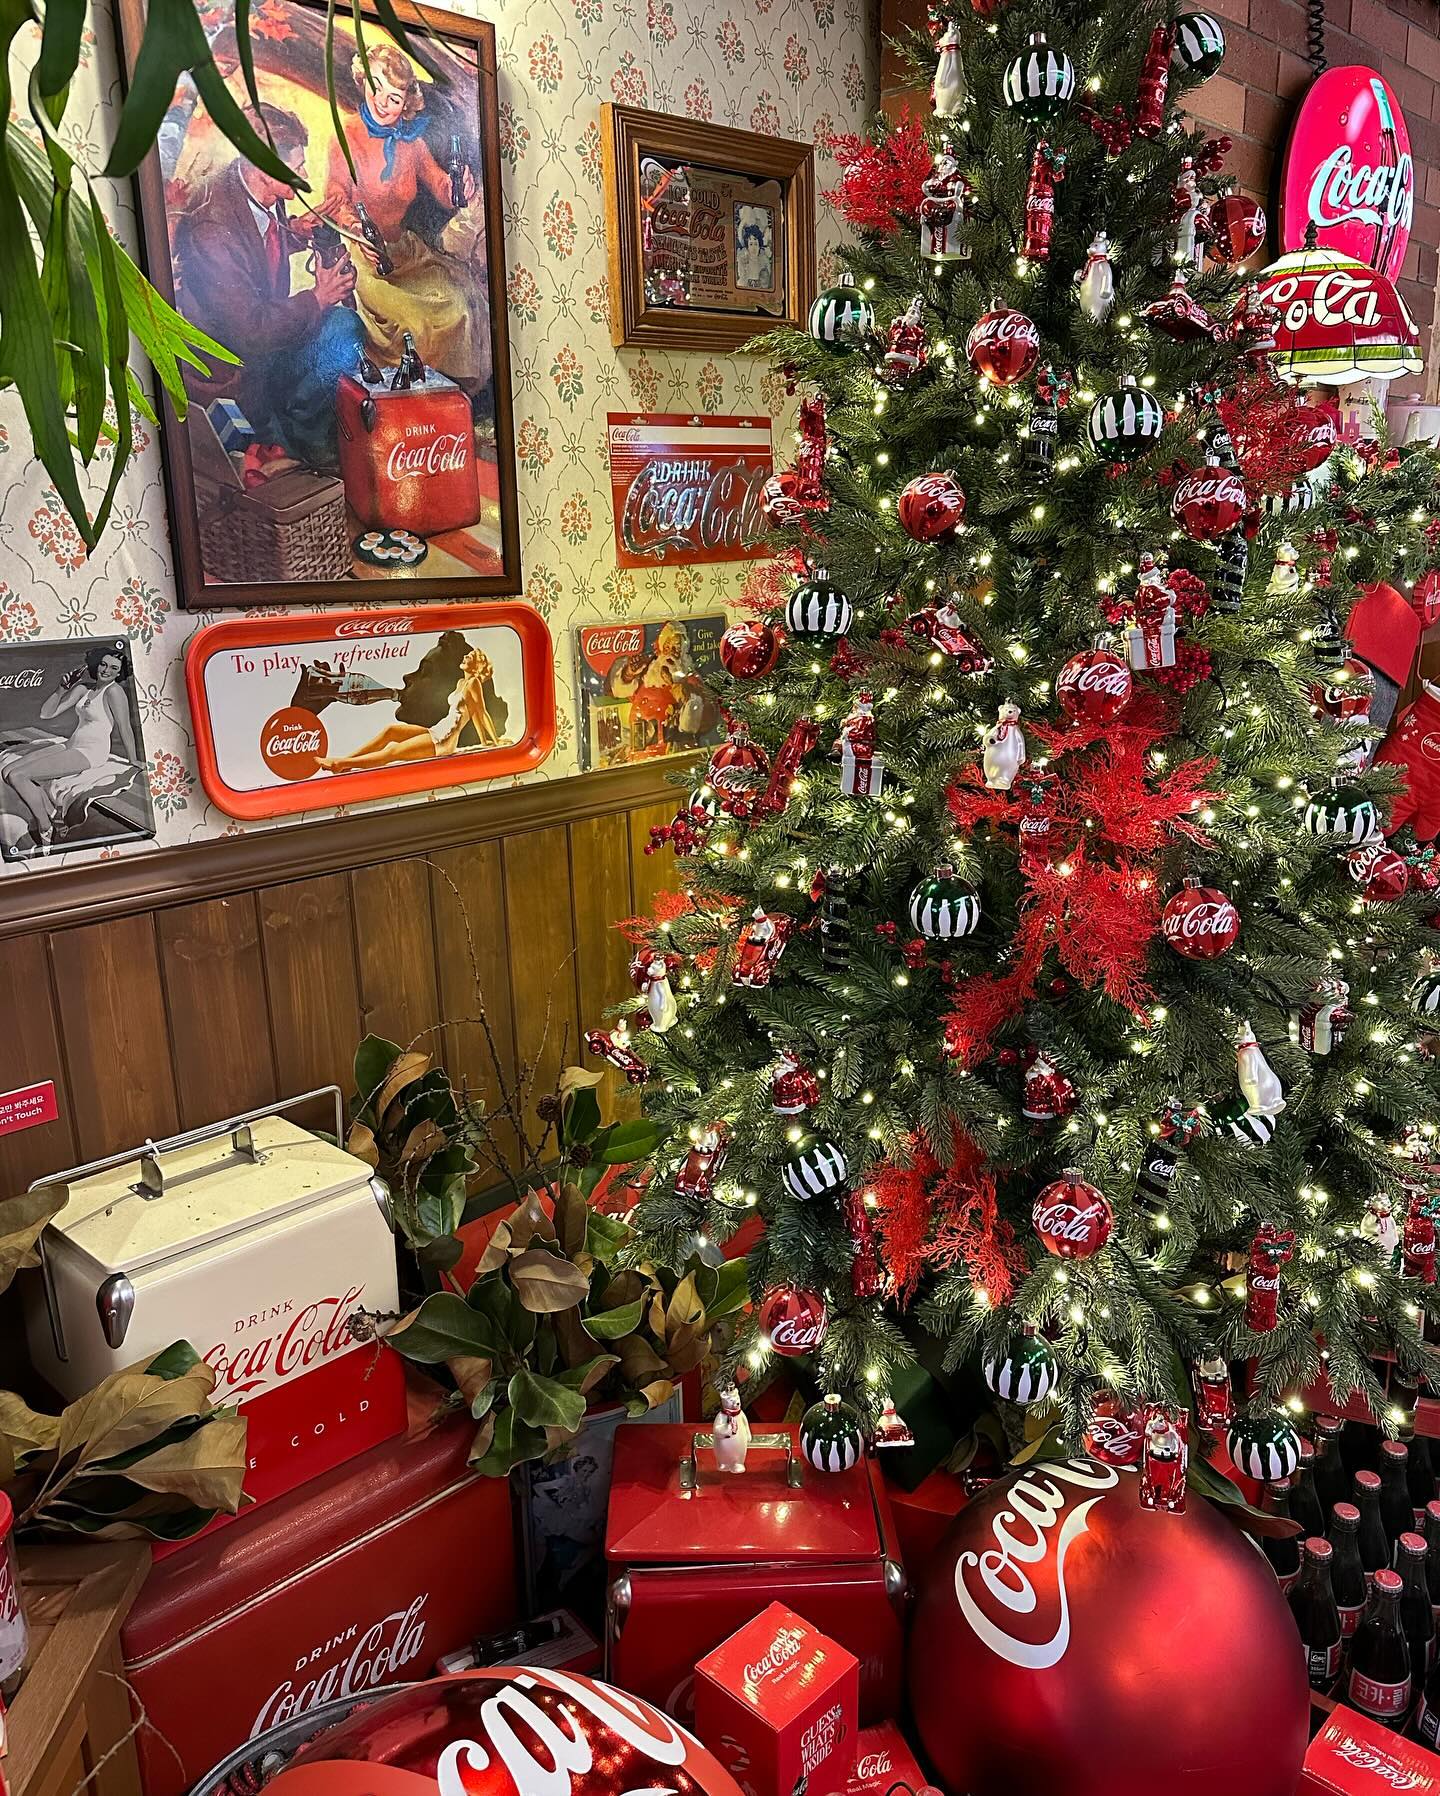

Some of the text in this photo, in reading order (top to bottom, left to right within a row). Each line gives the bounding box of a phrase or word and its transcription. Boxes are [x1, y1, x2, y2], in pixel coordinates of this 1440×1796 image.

[405, 424, 436, 437] DRINK
[387, 432, 469, 481] Coca-Cola
[335, 615, 417, 637] Coca-Cola
[586, 628, 641, 656] Coca-Cola
[231, 640, 410, 677] To play refreshed
[267, 729, 322, 757] Coca-Cola
[283, 723, 303, 732] Drink
[0, 1106, 43, 1125] n't Touch
[233, 1299, 294, 1334] DRINK
[291, 1400, 369, 1447] COLD
[295, 1623, 358, 1672] DRINK
[743, 1634, 803, 1685] Coca-Cola
[249, 1592, 429, 1741] Coca-Cola
[801, 1705, 836, 1748] GUESS
[803, 1738, 833, 1779] INSIDE
